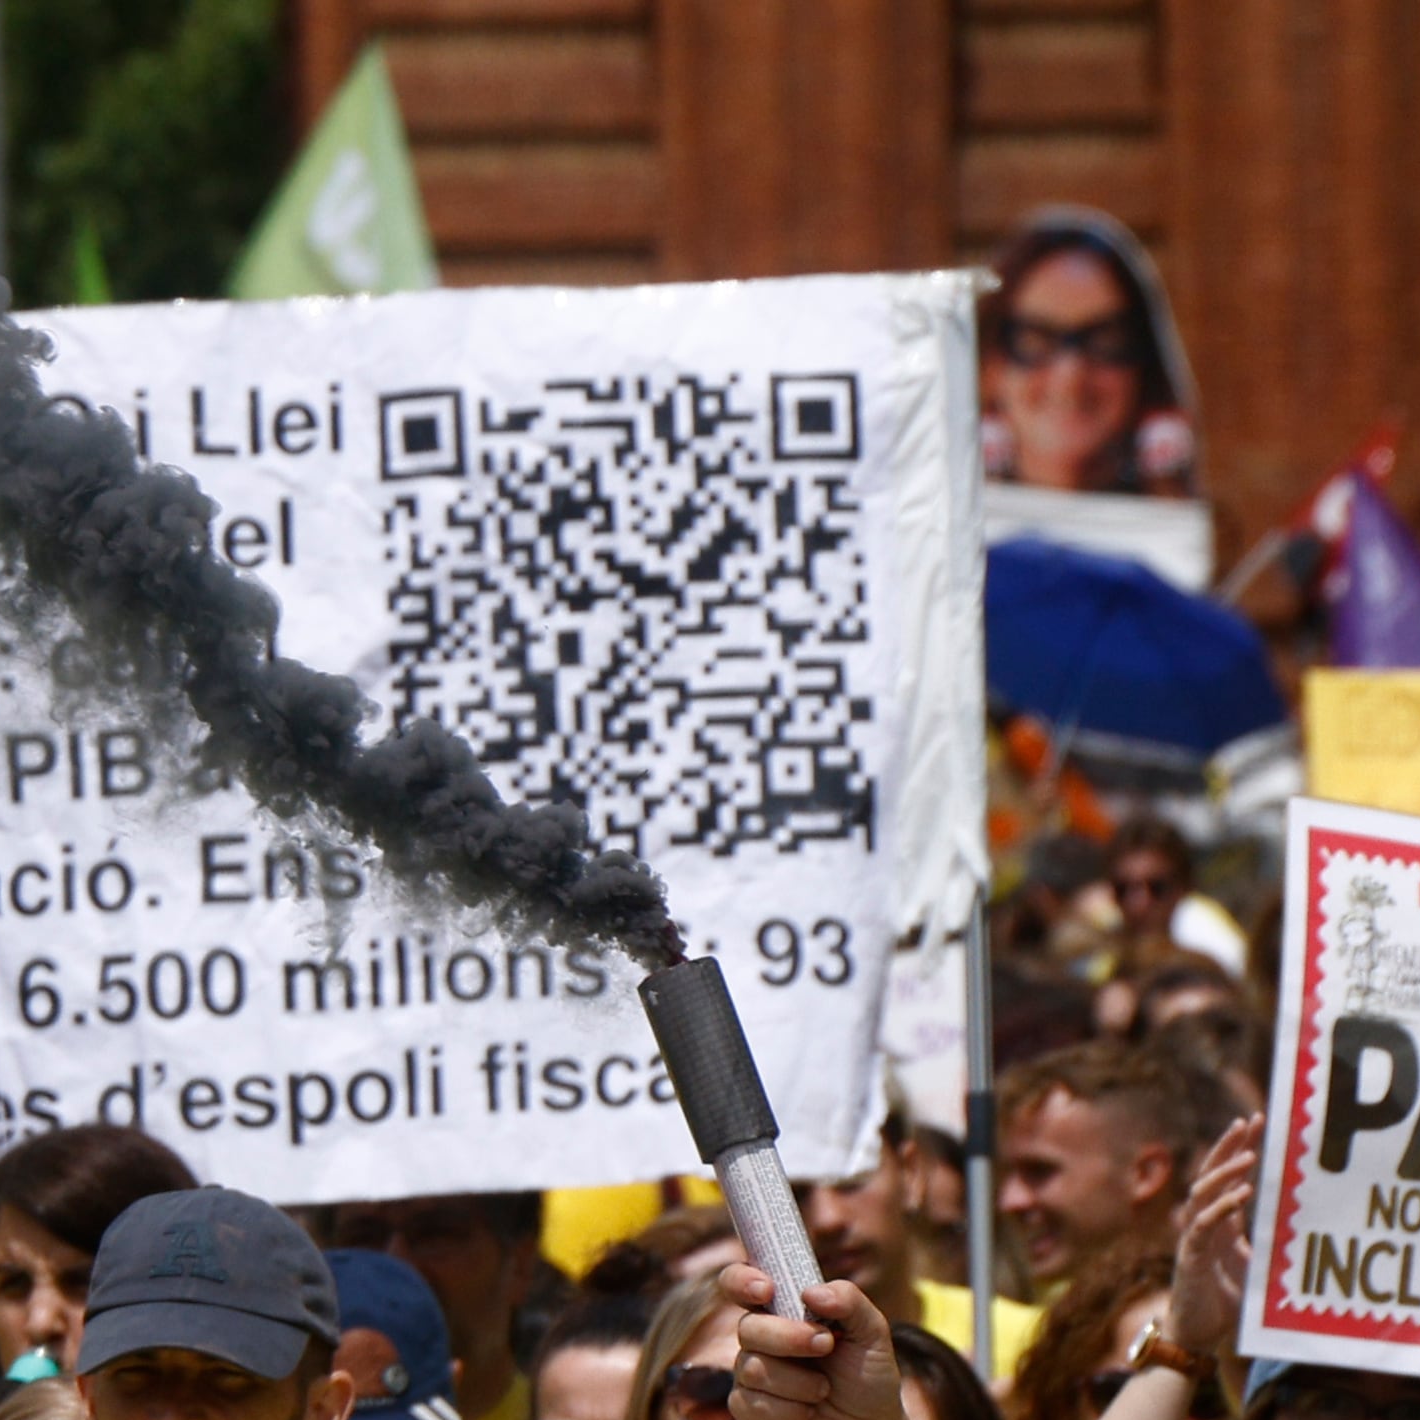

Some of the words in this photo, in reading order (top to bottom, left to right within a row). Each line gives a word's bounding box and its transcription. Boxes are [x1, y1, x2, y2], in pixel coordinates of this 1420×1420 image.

[190, 382, 343, 456] Llei
[208, 496, 294, 568] el
[5, 728, 152, 803] PIB
[200, 833, 366, 904] Ens
[17, 947, 247, 1029] 6.500
[284, 937, 609, 1012] milions
[755, 917, 856, 988] 93
[481, 1042, 680, 1115] fisca
